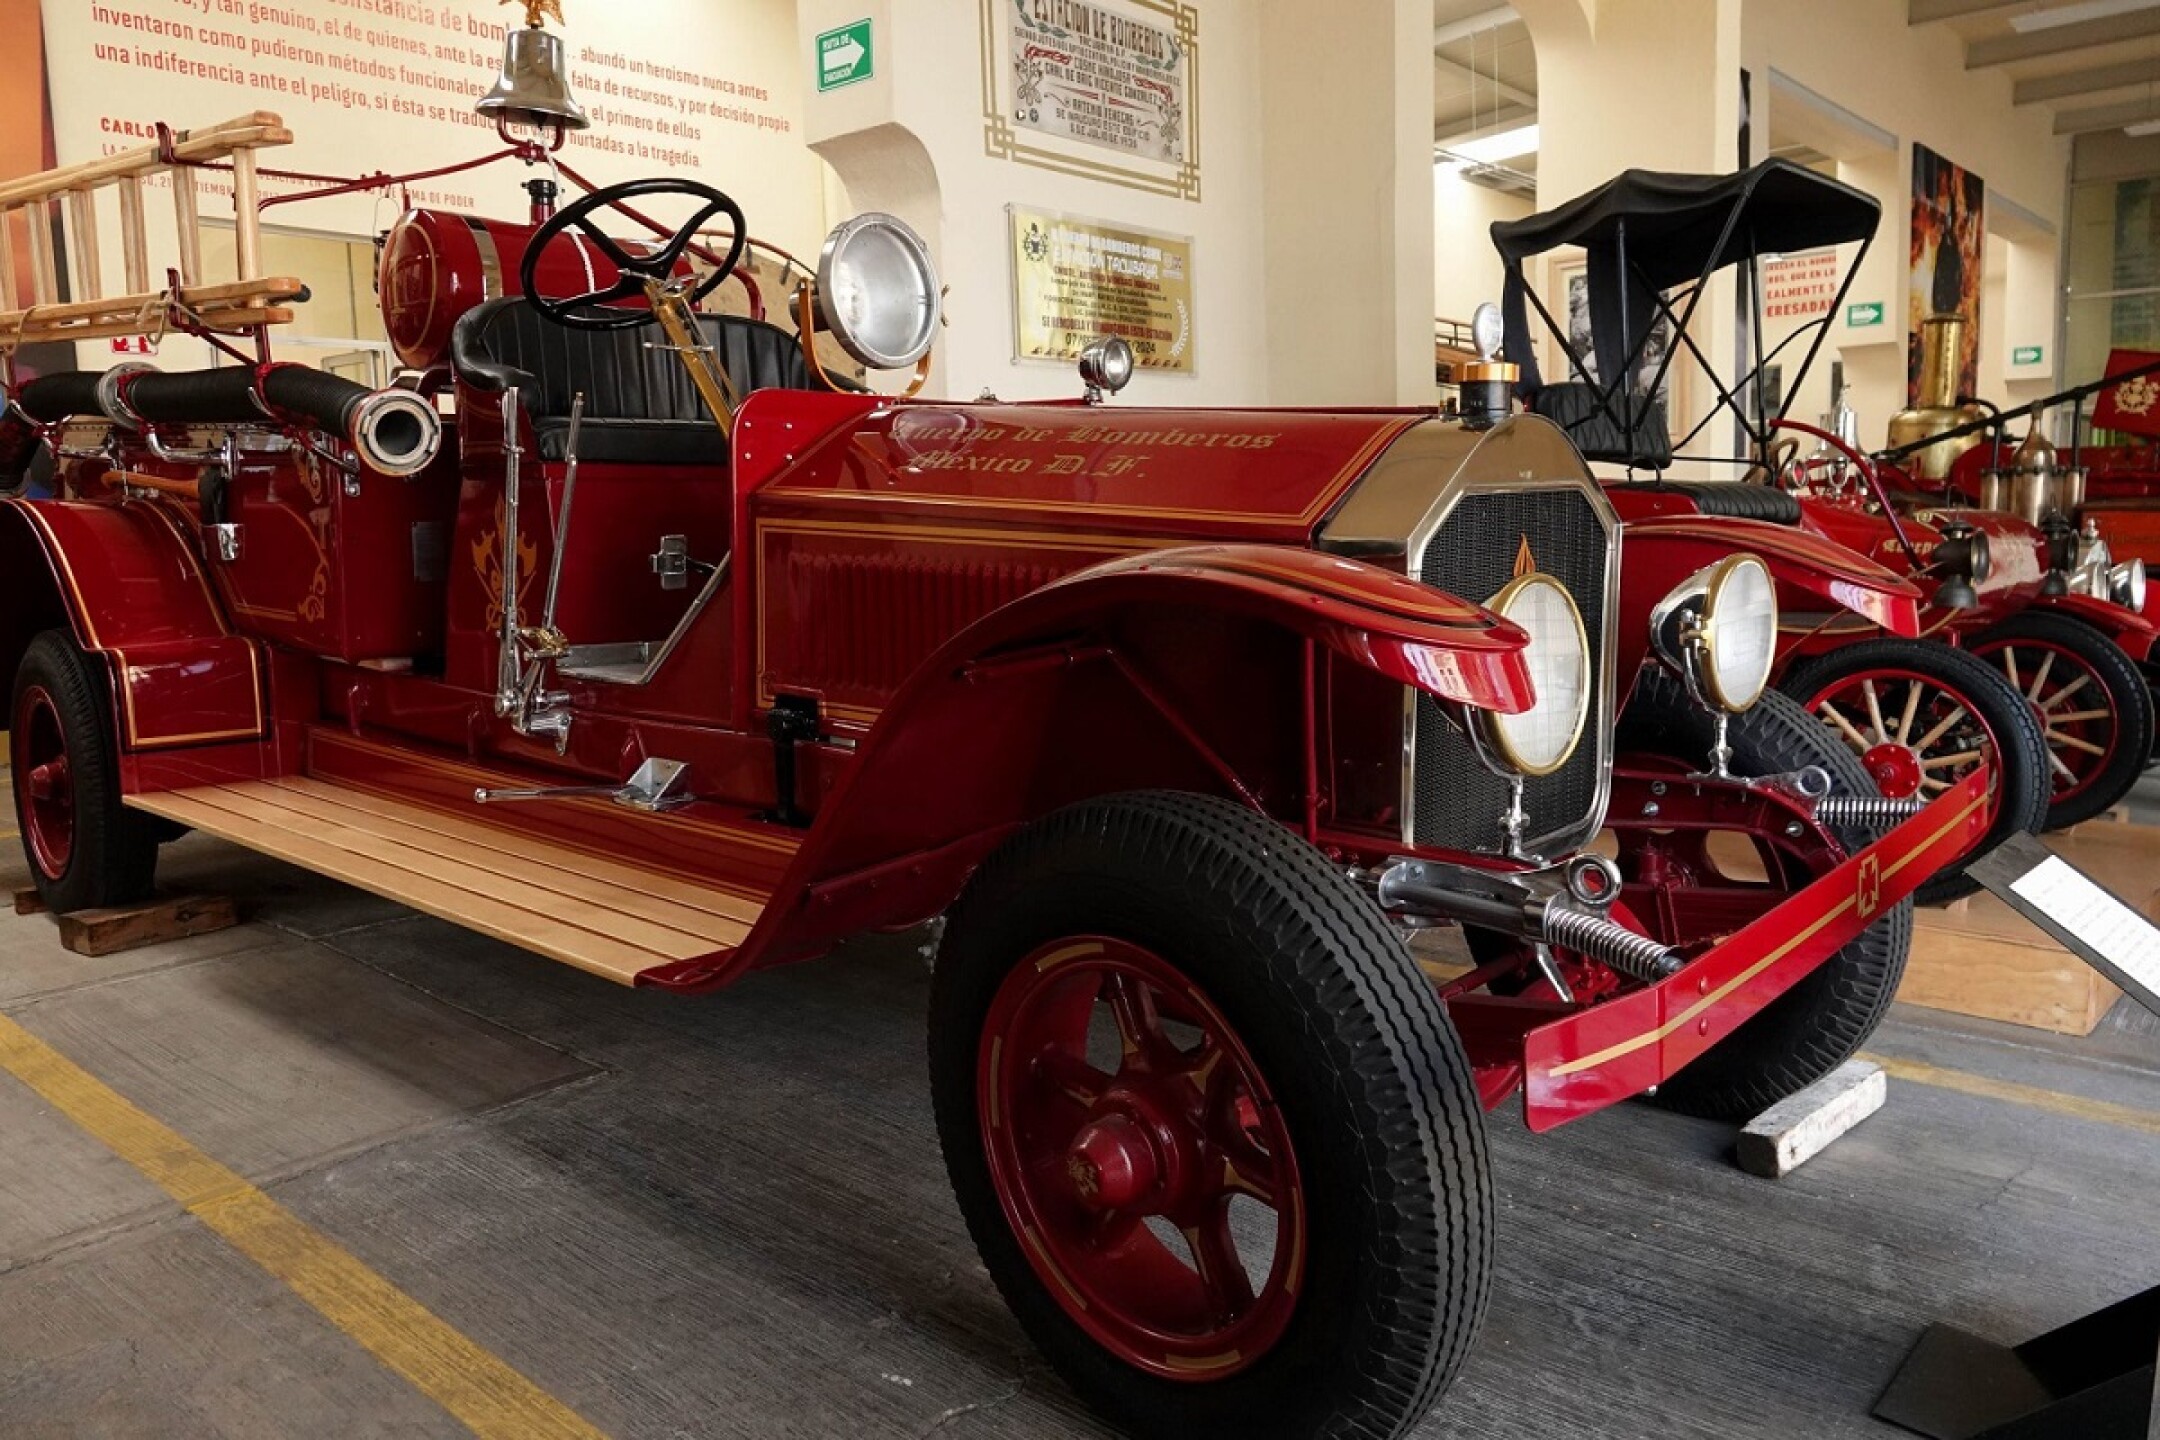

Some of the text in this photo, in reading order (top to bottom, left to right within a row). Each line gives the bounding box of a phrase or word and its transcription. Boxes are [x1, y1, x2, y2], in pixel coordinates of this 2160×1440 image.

[92, 1, 194, 41] inventaron
[199, 27, 246, 50] como
[251, 37, 325, 67] pudieron
[328, 53, 397, 82] métodos
[399, 64, 487, 98] funcionales
[591, 105, 604, 122] el
[606, 108, 653, 132] primero
[656, 117, 670, 134] de
[672, 121, 701, 140] ellos
[94, 42, 130, 64] una
[134, 45, 244, 85] indiferencia
[249, 71, 288, 92] ante
[291, 77, 307, 96] el
[311, 82, 372, 110] peligro,
[375, 92, 388, 111] si
[392, 95, 425, 118] ésta
[429, 105, 446, 122] se
[569, 129, 625, 155] hurtadas
[628, 141, 635, 156] a
[636, 141, 649, 159] la
[217, 0, 244, 16] tan
[250, 2, 321, 36] genuino,
[324, 18, 340, 37] el
[343, 20, 362, 42] de
[366, 29, 431, 58] quienes,
[434, 44, 466, 64] ante
[469, 49, 483, 67] la
[571, 69, 601, 92] falta
[604, 78, 619, 97] de
[622, 84, 678, 111] recursos,
[678, 97, 686, 114] y
[689, 98, 707, 117] por
[757, 112, 791, 134] propia
[441, 8, 462, 32] de
[580, 46, 626, 70] abundó
[629, 58, 644, 74] un
[702, 75, 735, 95] nunca
[738, 82, 769, 102] antes
[100, 116, 157, 140] CARLO
[1012, 425, 1054, 442] de
[1057, 424, 1282, 449] Bomberos
